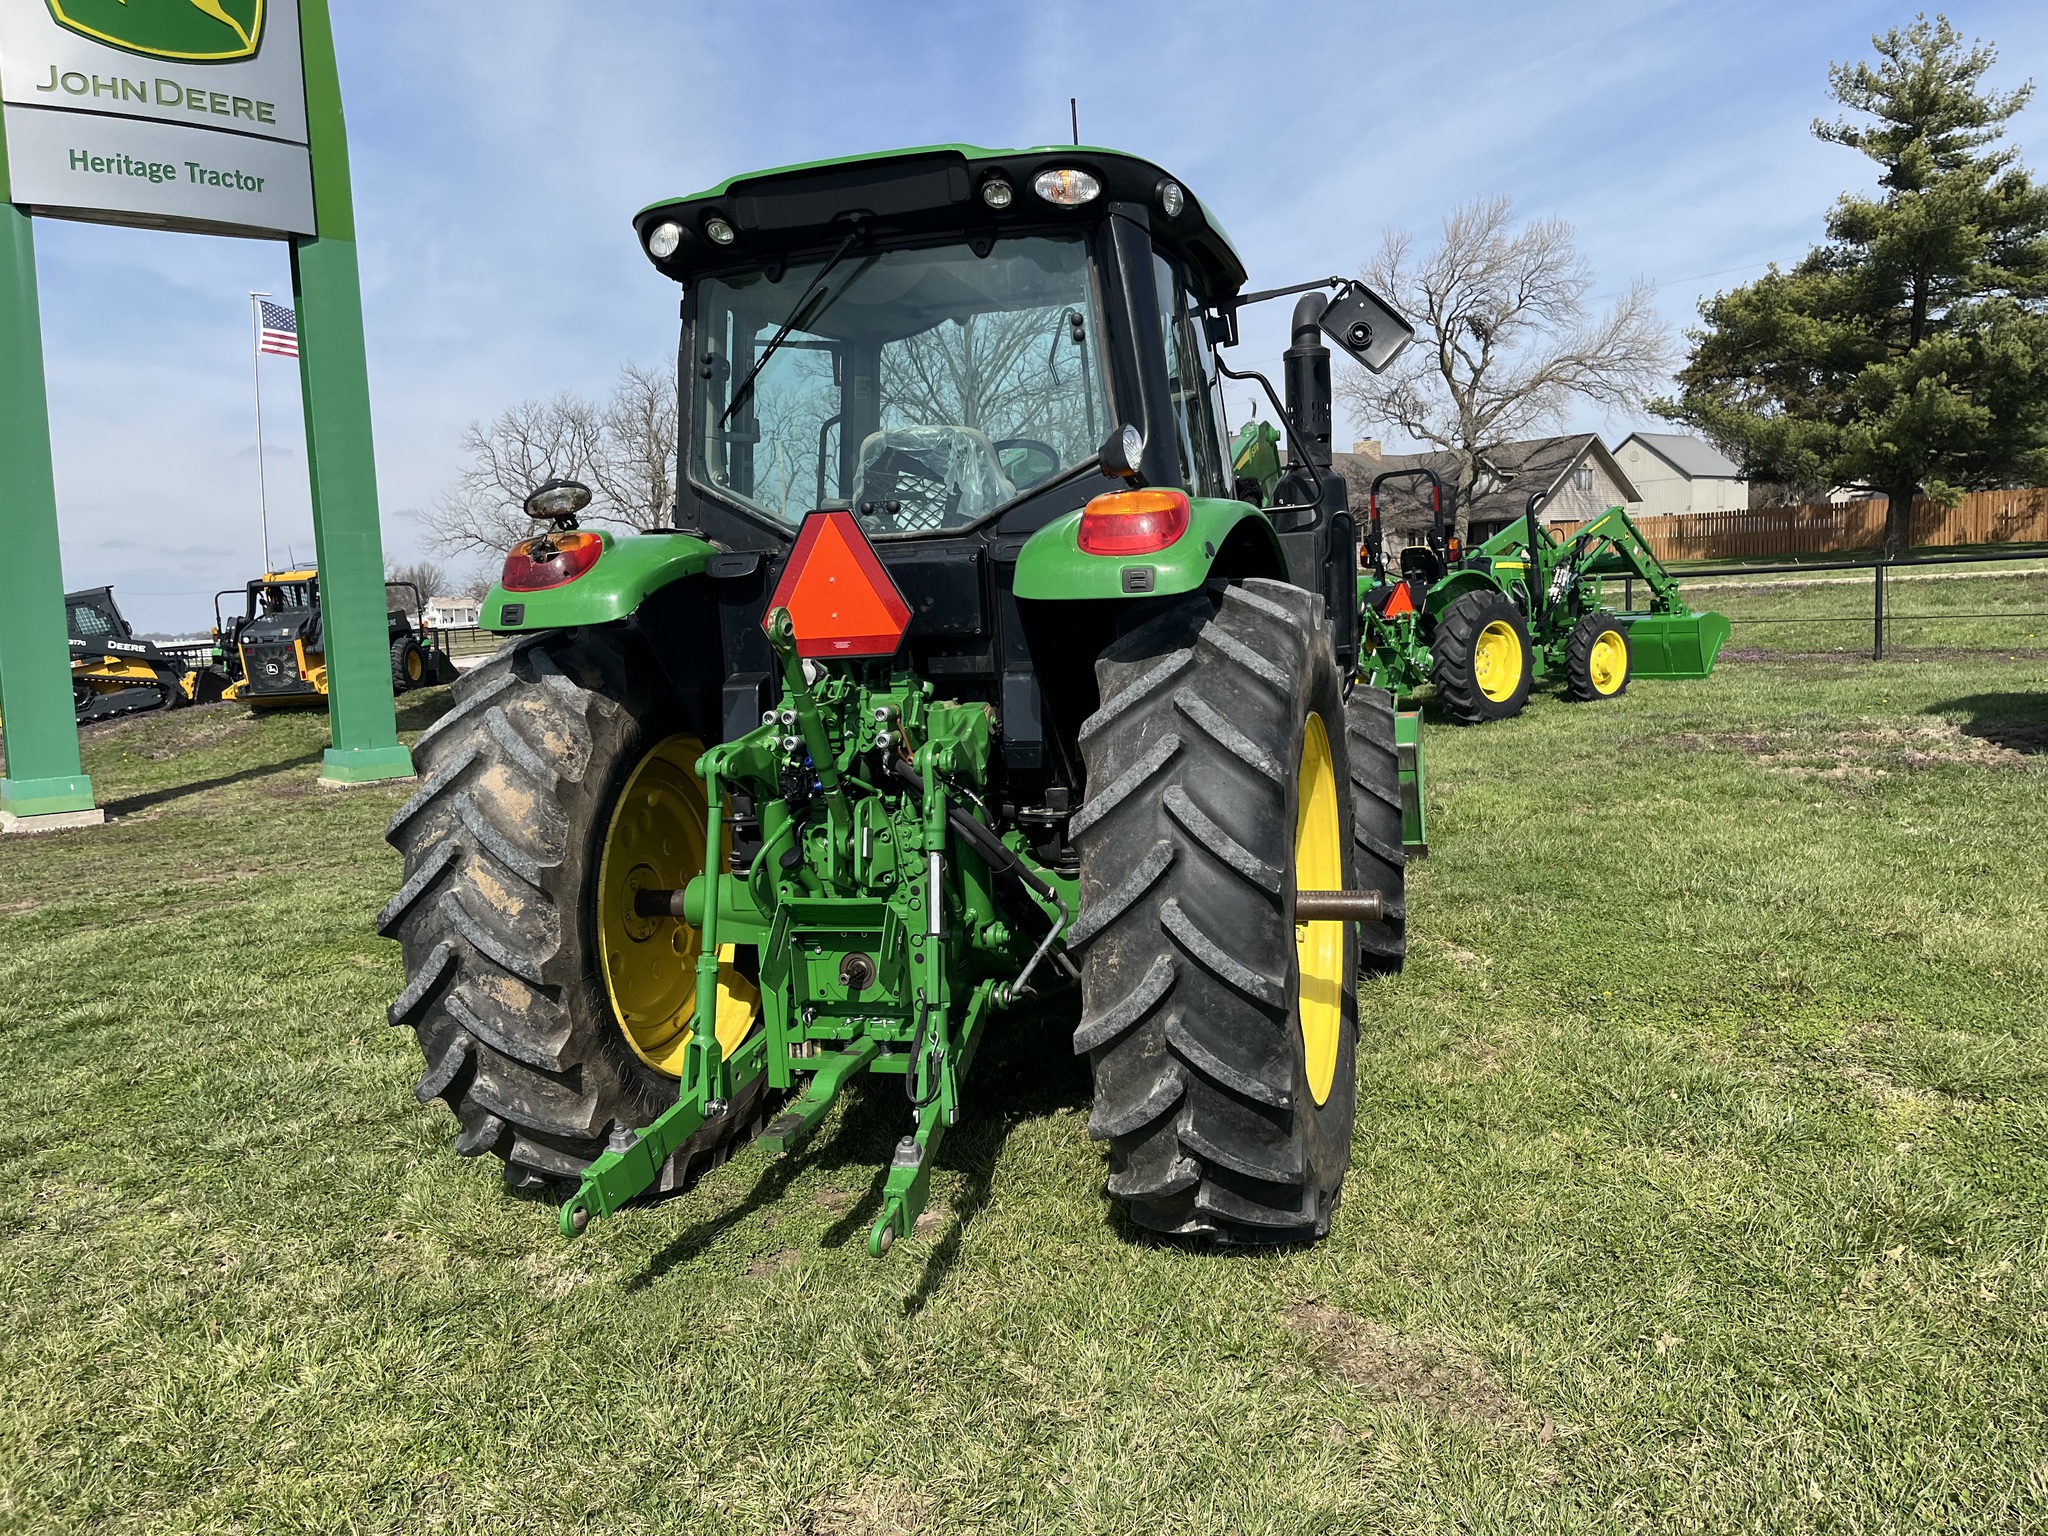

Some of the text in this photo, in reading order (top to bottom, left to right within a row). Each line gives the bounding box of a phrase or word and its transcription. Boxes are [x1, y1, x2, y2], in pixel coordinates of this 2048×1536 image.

[36, 65, 276, 125] JOHN DEERE
[69, 149, 265, 193] Heritage Tractor
[107, 640, 147, 653] DEERE
